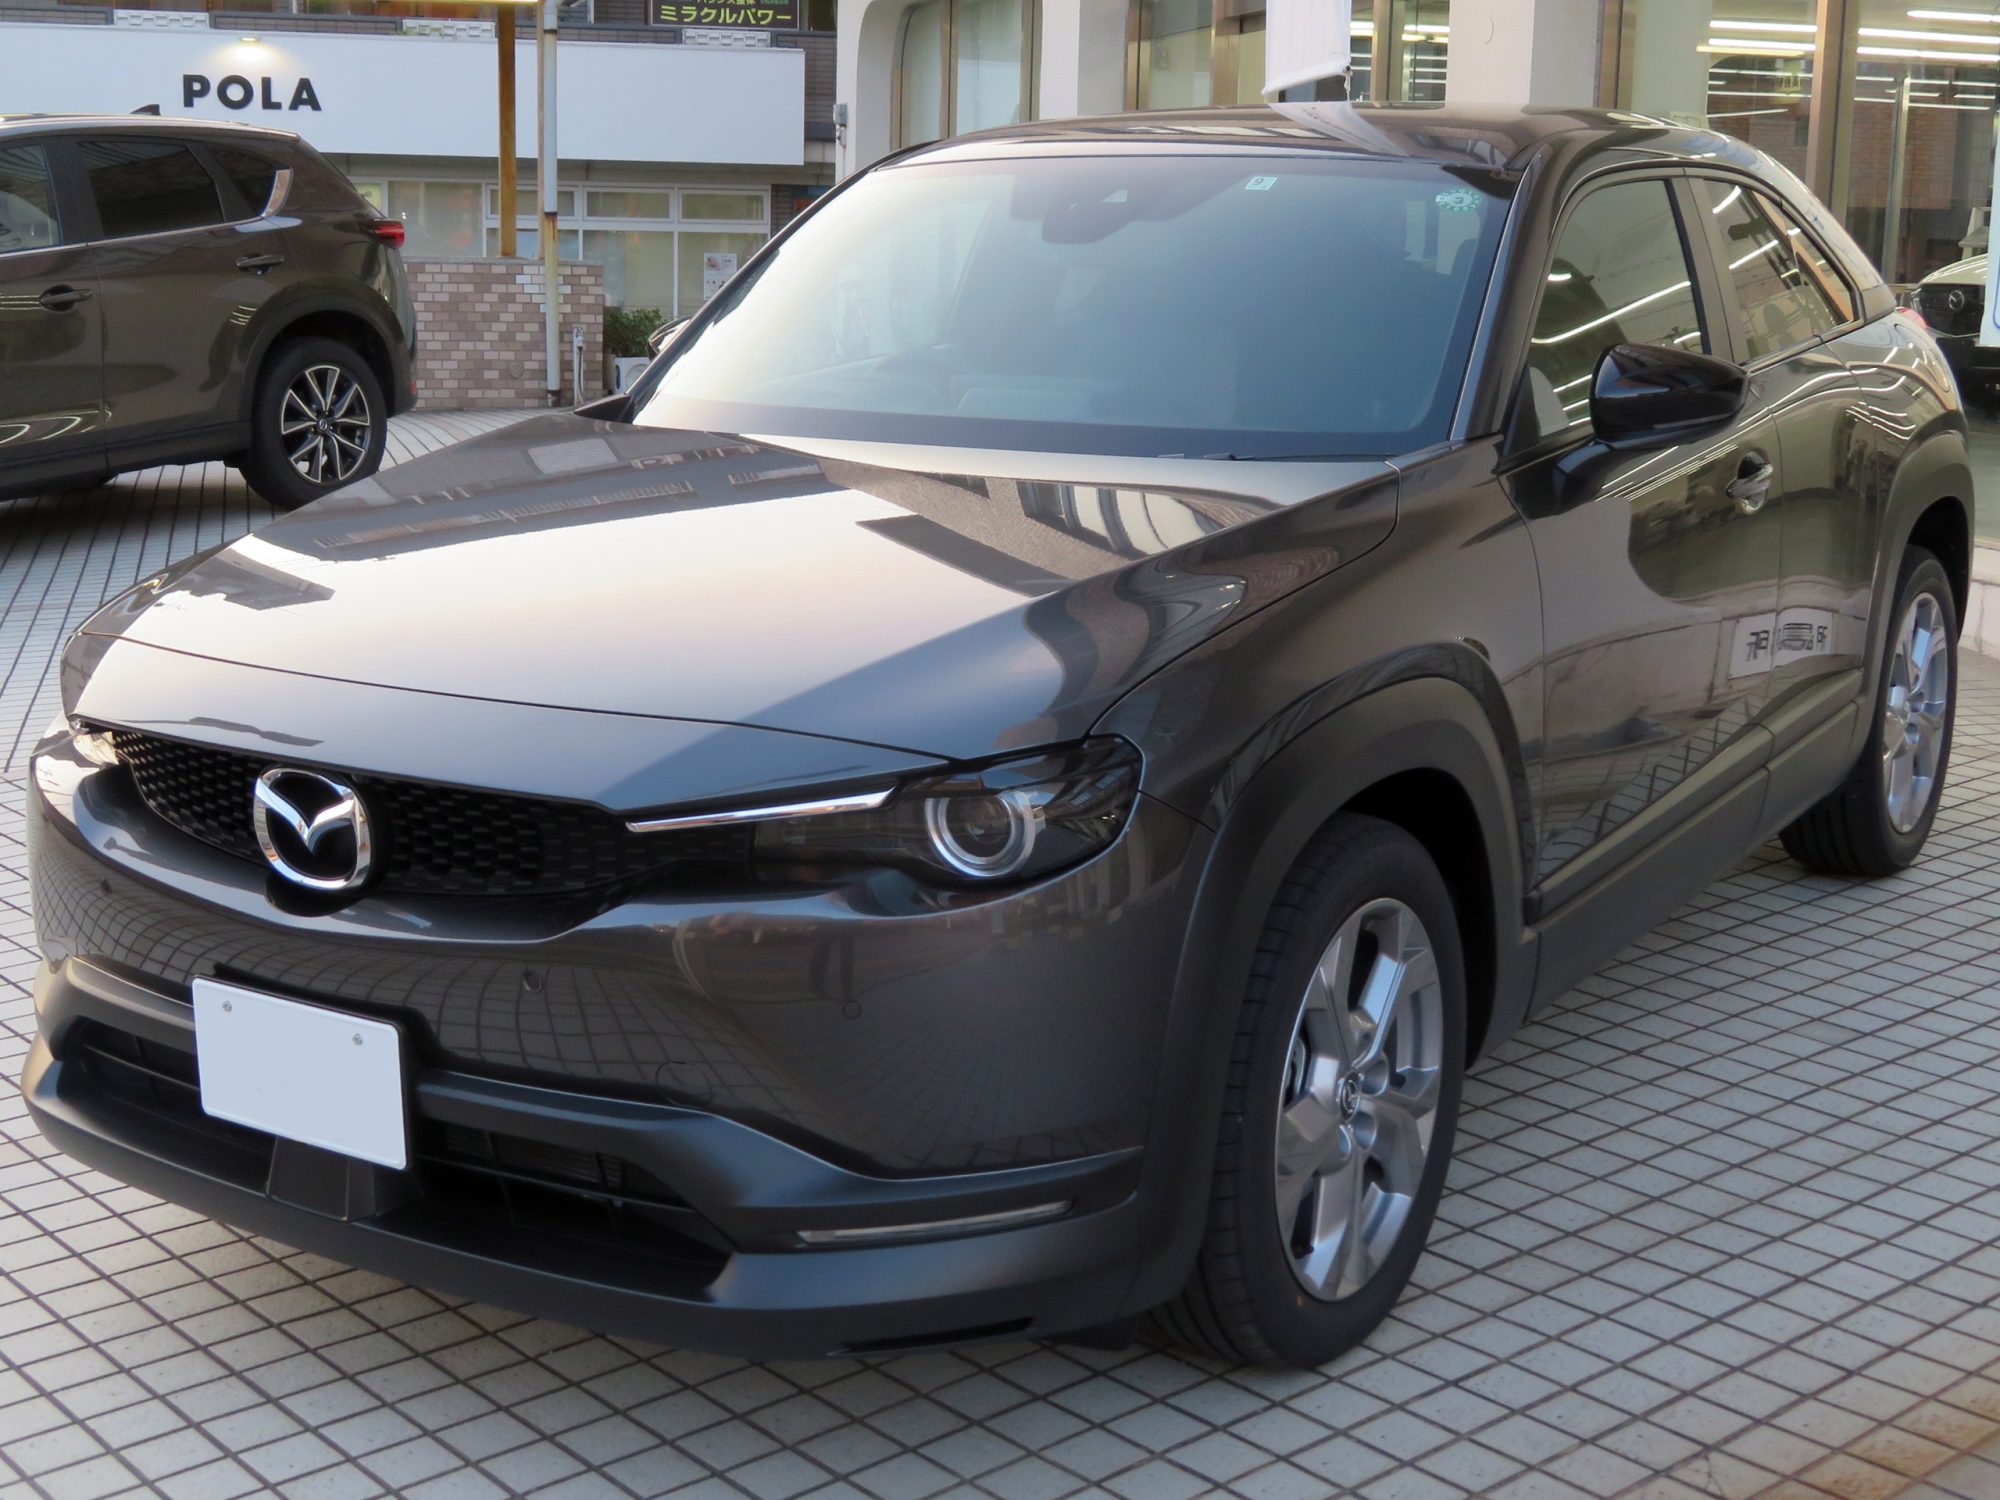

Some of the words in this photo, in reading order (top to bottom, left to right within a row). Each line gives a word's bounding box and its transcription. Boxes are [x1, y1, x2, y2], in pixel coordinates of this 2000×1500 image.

[660, 5, 792, 24] ミラクルパワー
[183, 74, 322, 111] POLA
